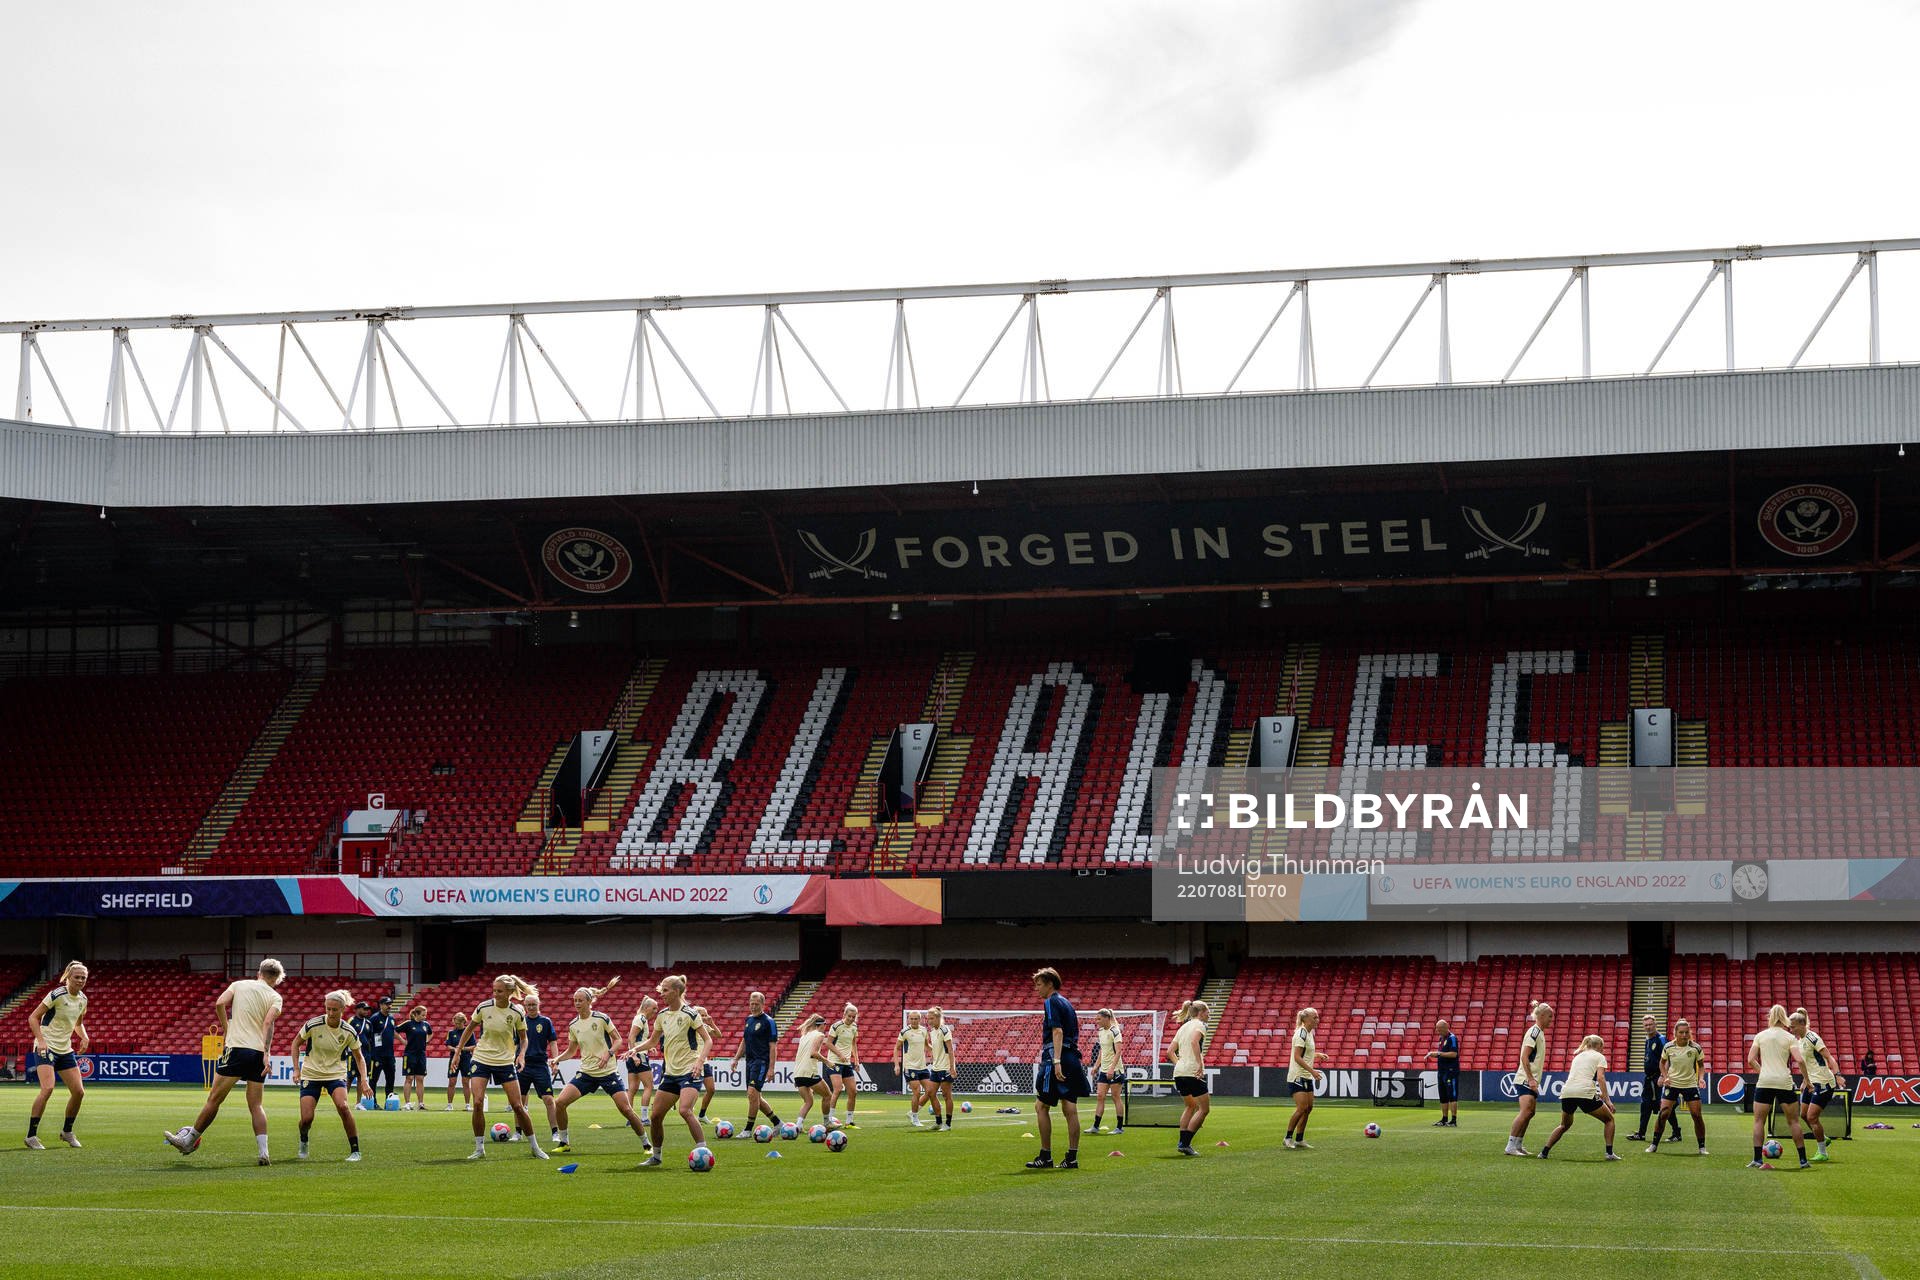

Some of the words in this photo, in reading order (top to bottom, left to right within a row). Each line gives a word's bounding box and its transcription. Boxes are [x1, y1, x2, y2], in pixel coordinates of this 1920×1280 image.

[895, 530, 1139, 569] FORGED
[1170, 526, 1230, 561] IN
[1261, 518, 1448, 559] STEEL
[1273, 721, 1282, 733] D
[1648, 714, 1657, 726] C
[593, 735, 601, 747] F
[913, 729, 921, 740] E
[370, 795, 383, 809] G
[1413, 877, 1452, 890] UEFA
[1455, 876, 1526, 889] WOMEN'S
[1531, 876, 1572, 889] EURO
[1576, 875, 1648, 888] ENGLAND
[1652, 874, 1686, 888] 2022
[101, 893, 193, 909] SHEFFIELD
[423, 889, 466, 903] UEFA
[469, 888, 550, 903] WOMEN'S
[554, 888, 600, 902] EURO
[605, 888, 685, 902] ENGLAND
[690, 888, 727, 902] 2022
[99, 1061, 170, 1075] RESPECT
[977, 1081, 1018, 1093] adidas
[1312, 1070, 1359, 1097] OIN
[1370, 1071, 1406, 1098] US
[1853, 1076, 1920, 1105] MAX
